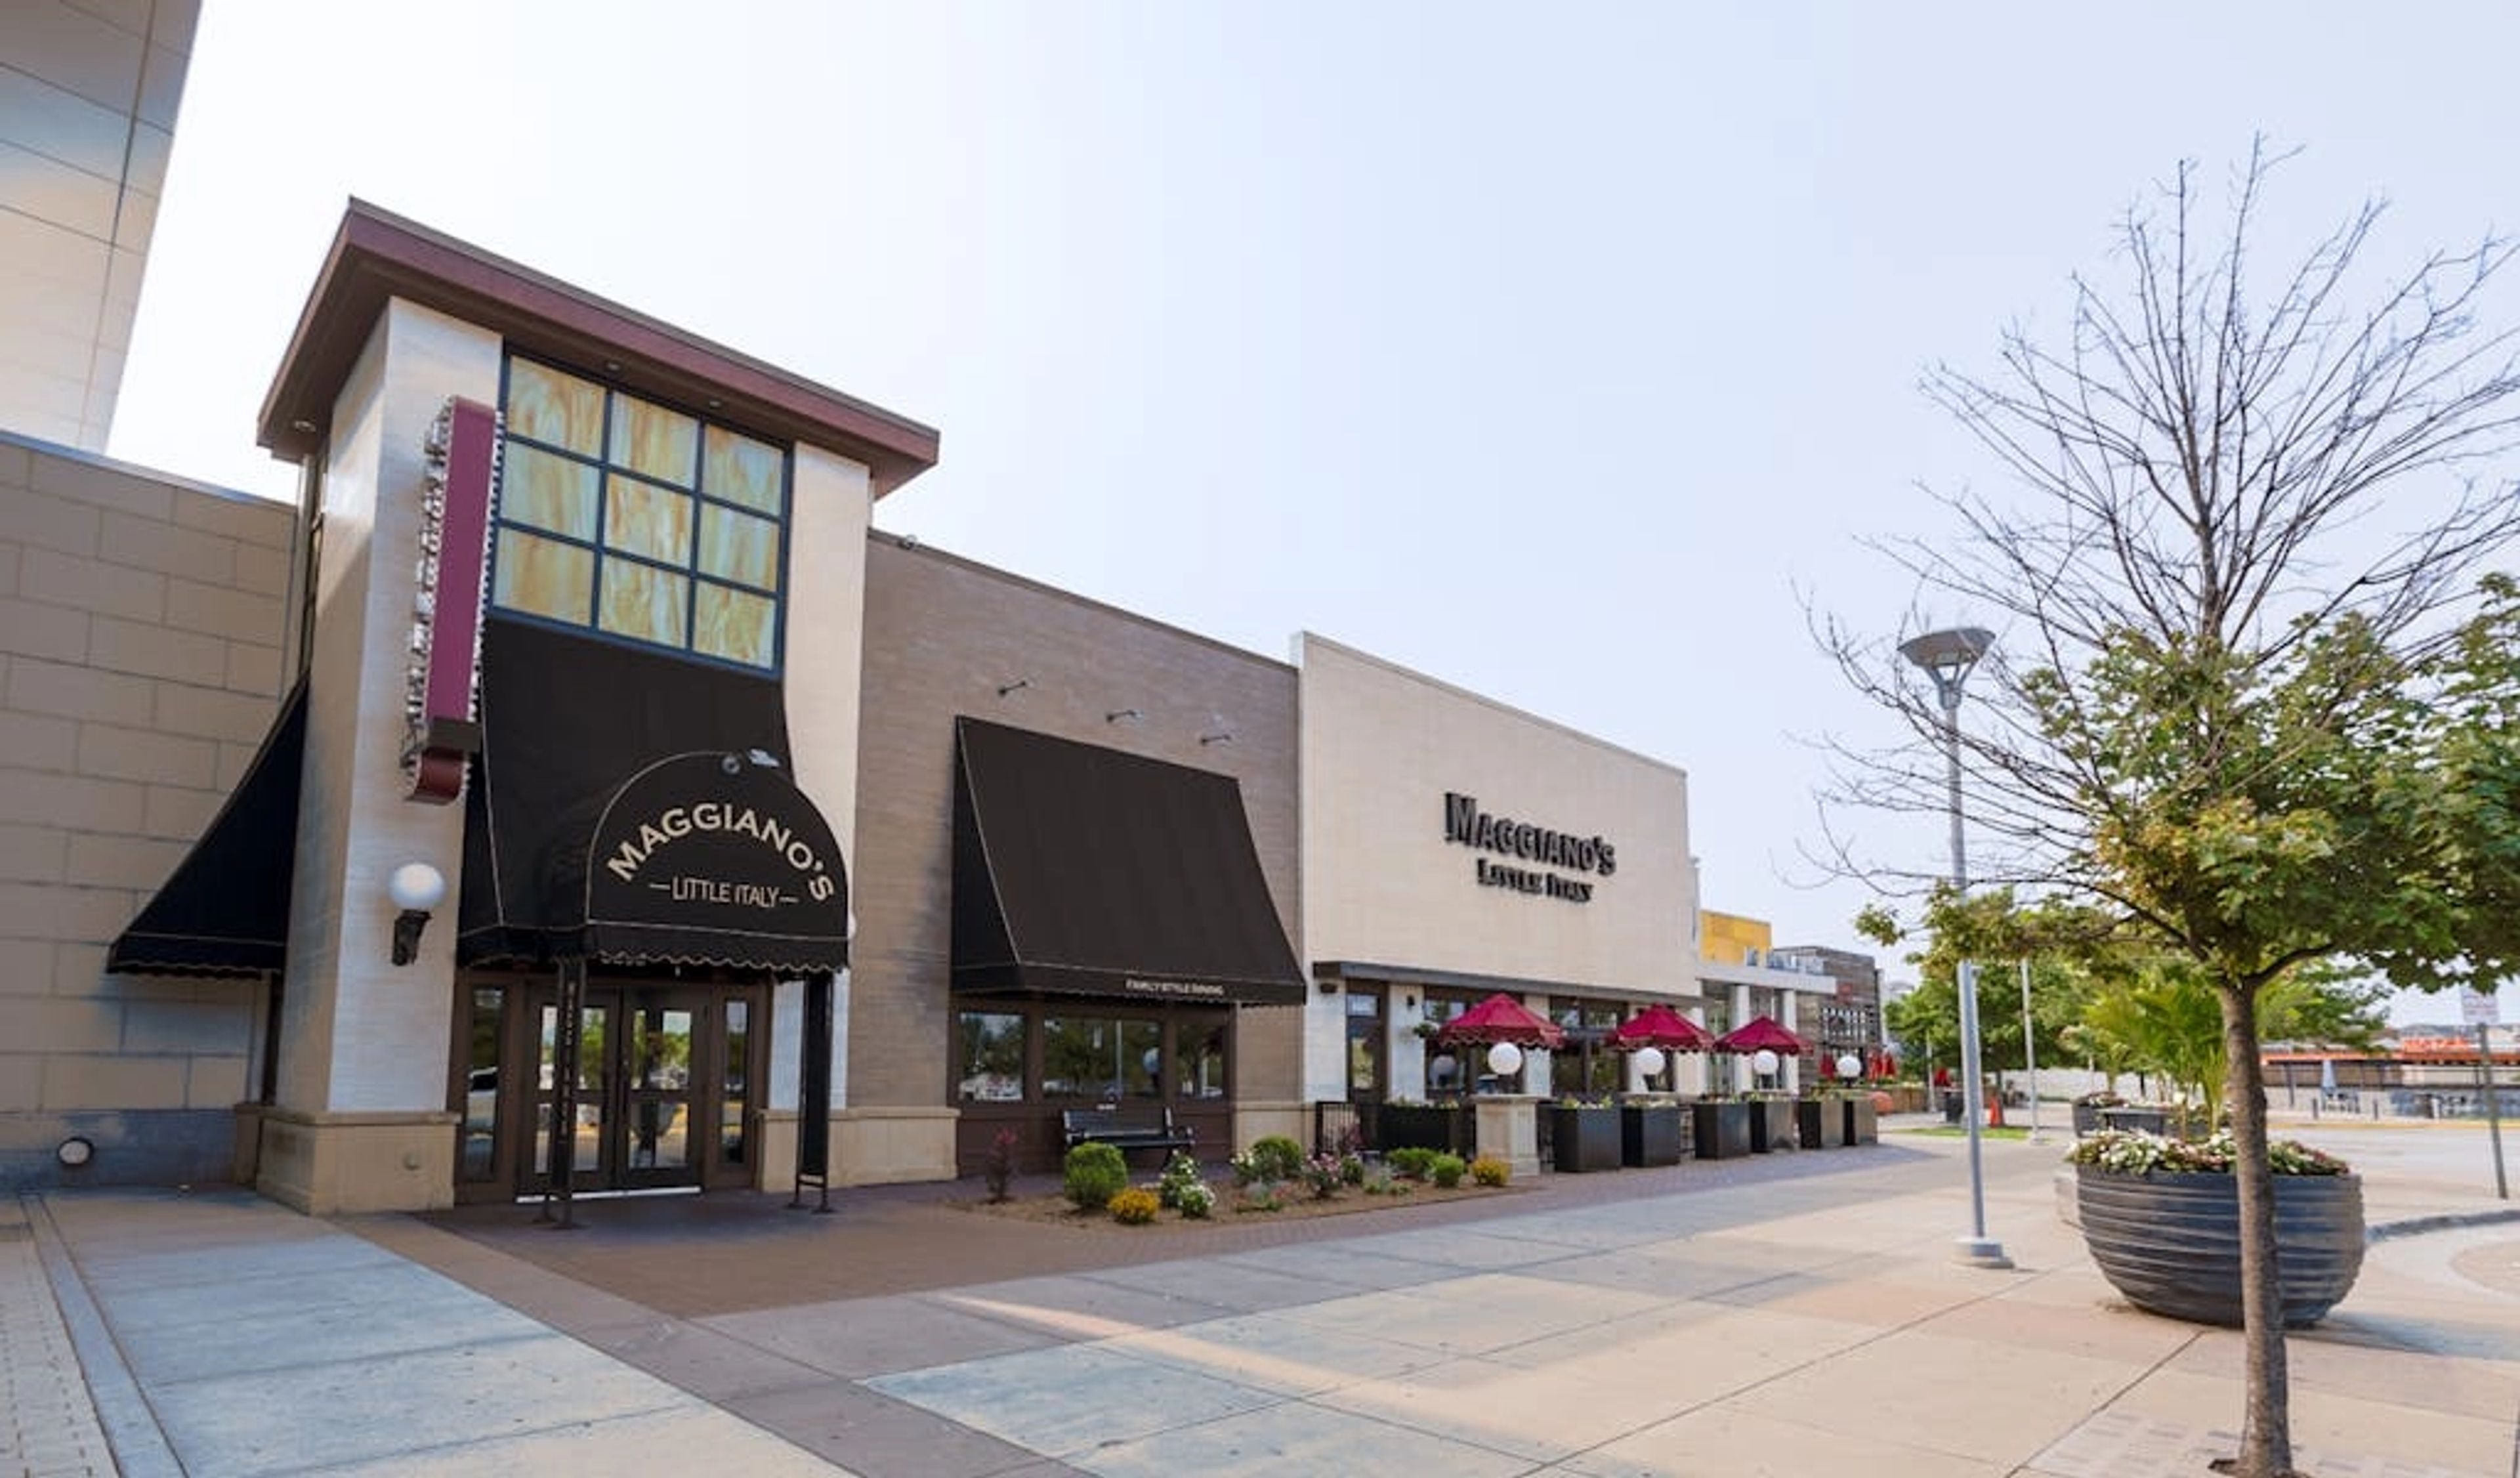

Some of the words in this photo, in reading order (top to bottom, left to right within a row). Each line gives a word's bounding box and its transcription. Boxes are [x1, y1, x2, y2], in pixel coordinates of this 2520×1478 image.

[607, 803, 834, 900] MAGGIANO'S
[1445, 792, 1616, 875] MAGGIANO'S
[672, 876, 731, 902] LITTLE
[734, 883, 780, 907] ITALY
[1478, 858, 1542, 893] LITTLE
